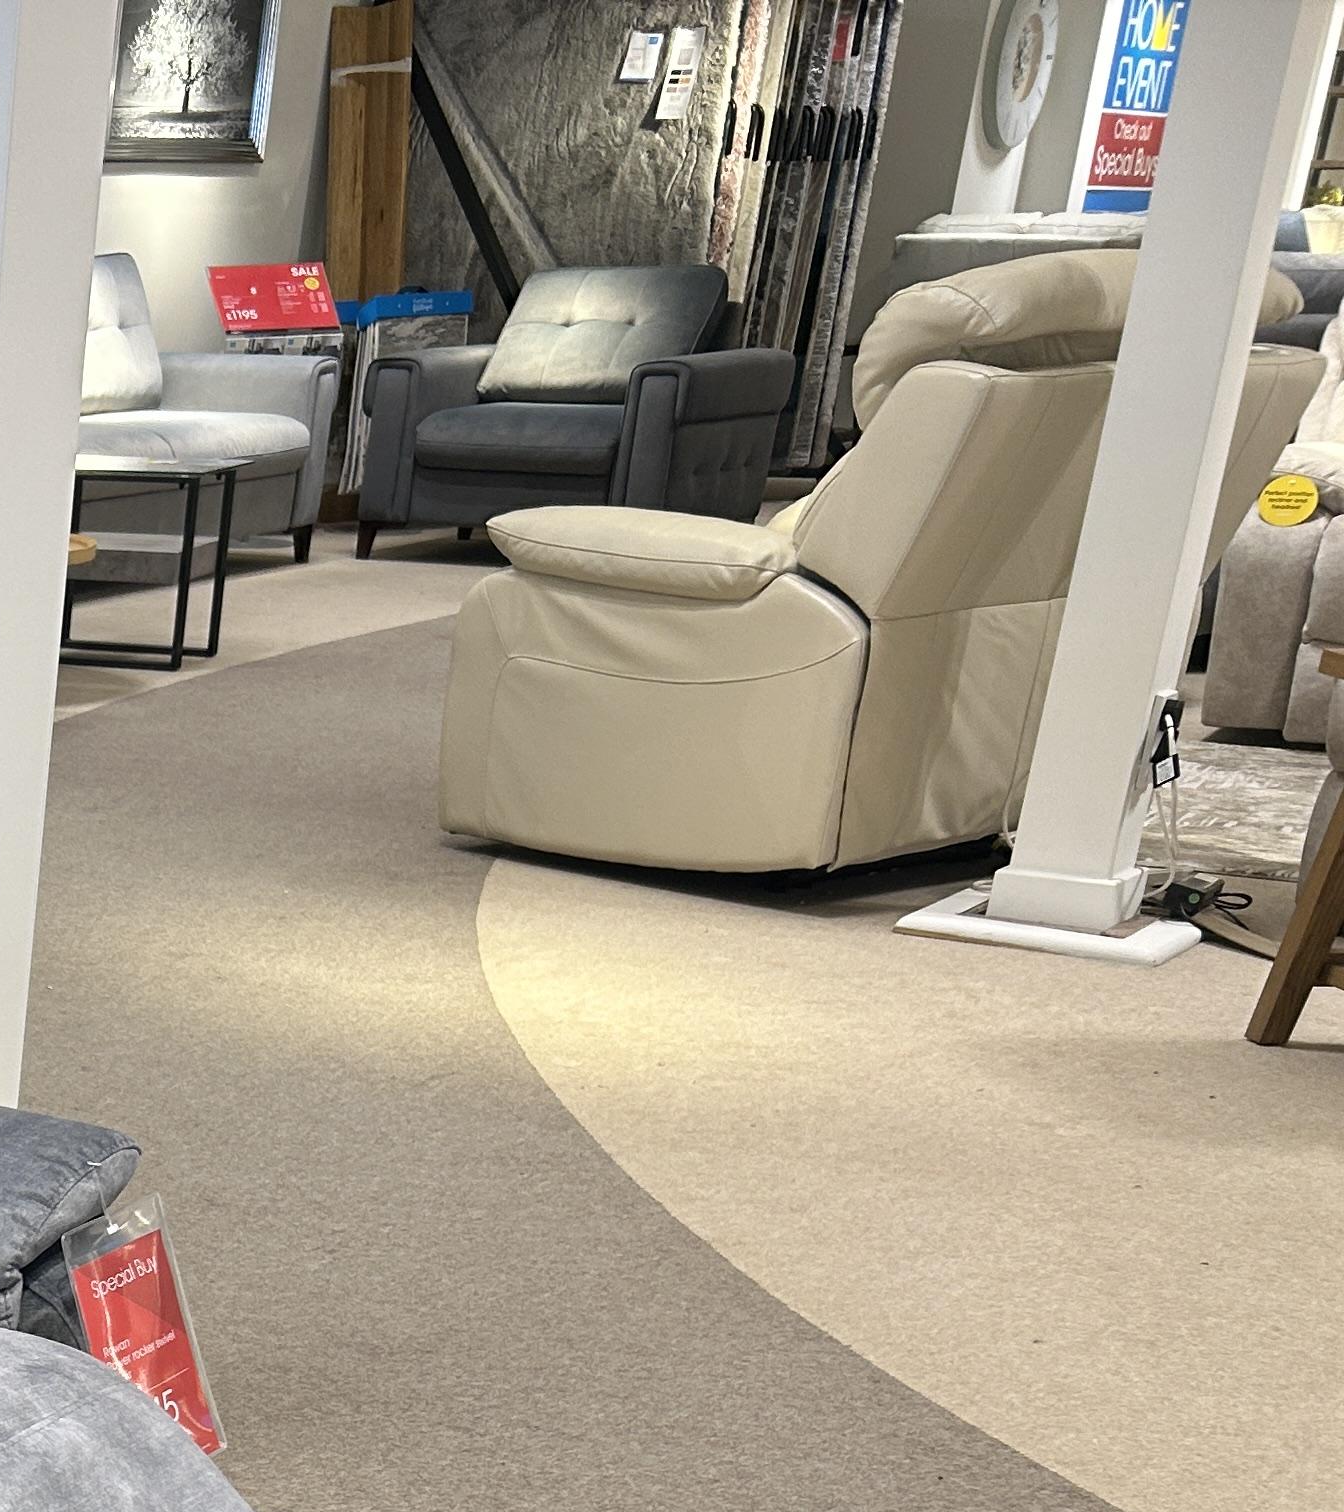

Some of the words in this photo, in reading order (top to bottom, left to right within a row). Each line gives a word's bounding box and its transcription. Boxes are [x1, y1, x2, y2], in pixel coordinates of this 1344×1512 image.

[1122, 0, 1185, 52] HOME
[1112, 56, 1172, 110] EVENT
[1114, 119, 1139, 140] Check
[1139, 121, 1153, 142] out
[1095, 145, 1136, 182] Special
[290, 265, 320, 277] SALE
[90, 1261, 137, 1299] Special
[133, 1255, 158, 1278] Buy
